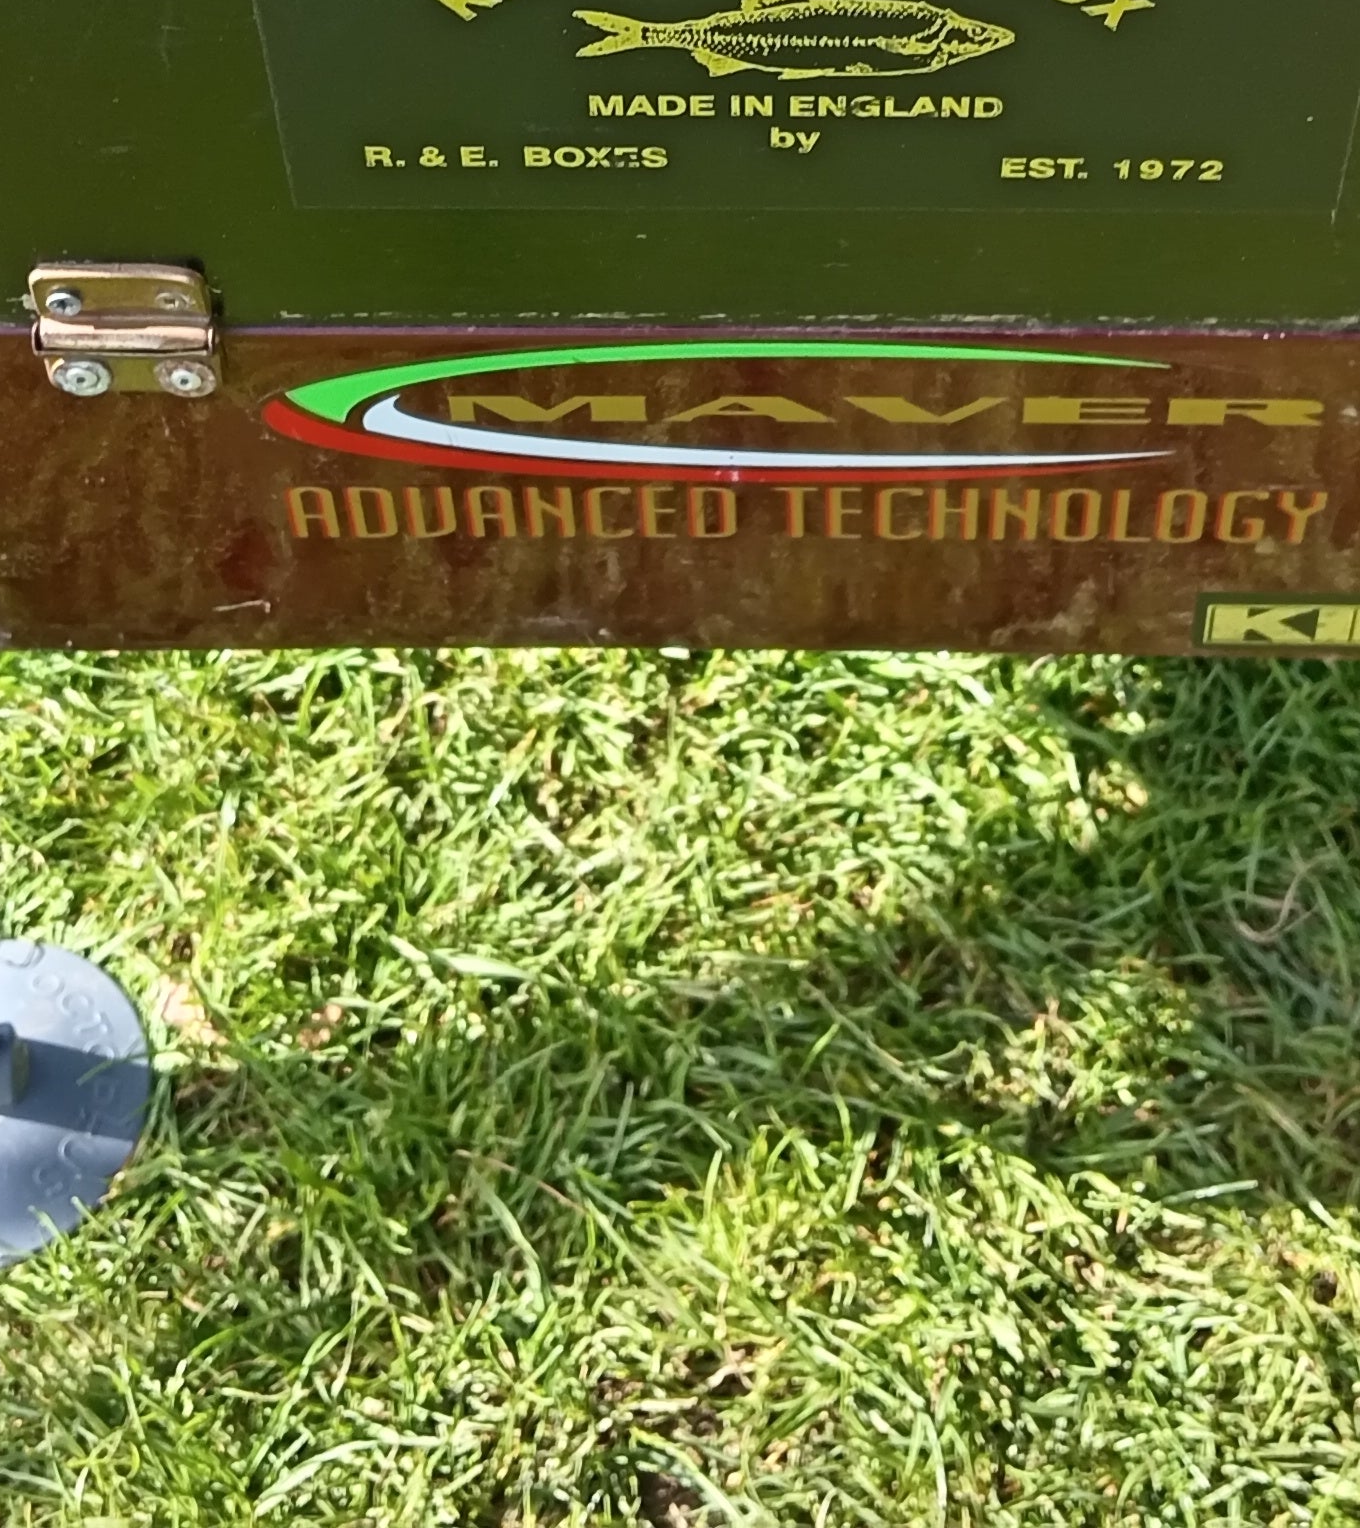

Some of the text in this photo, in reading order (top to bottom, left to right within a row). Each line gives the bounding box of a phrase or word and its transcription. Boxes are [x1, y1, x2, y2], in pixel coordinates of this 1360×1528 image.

[588, 94, 1004, 119] MADE IN ENGLAND
[769, 126, 821, 154] by
[363, 146, 669, 169] R. & E. BOXES
[1000, 157, 1225, 182] EST. 1972
[447, 394, 1325, 426] MAVER
[286, 485, 1329, 545] ADVANCED TECHNOLOGY
